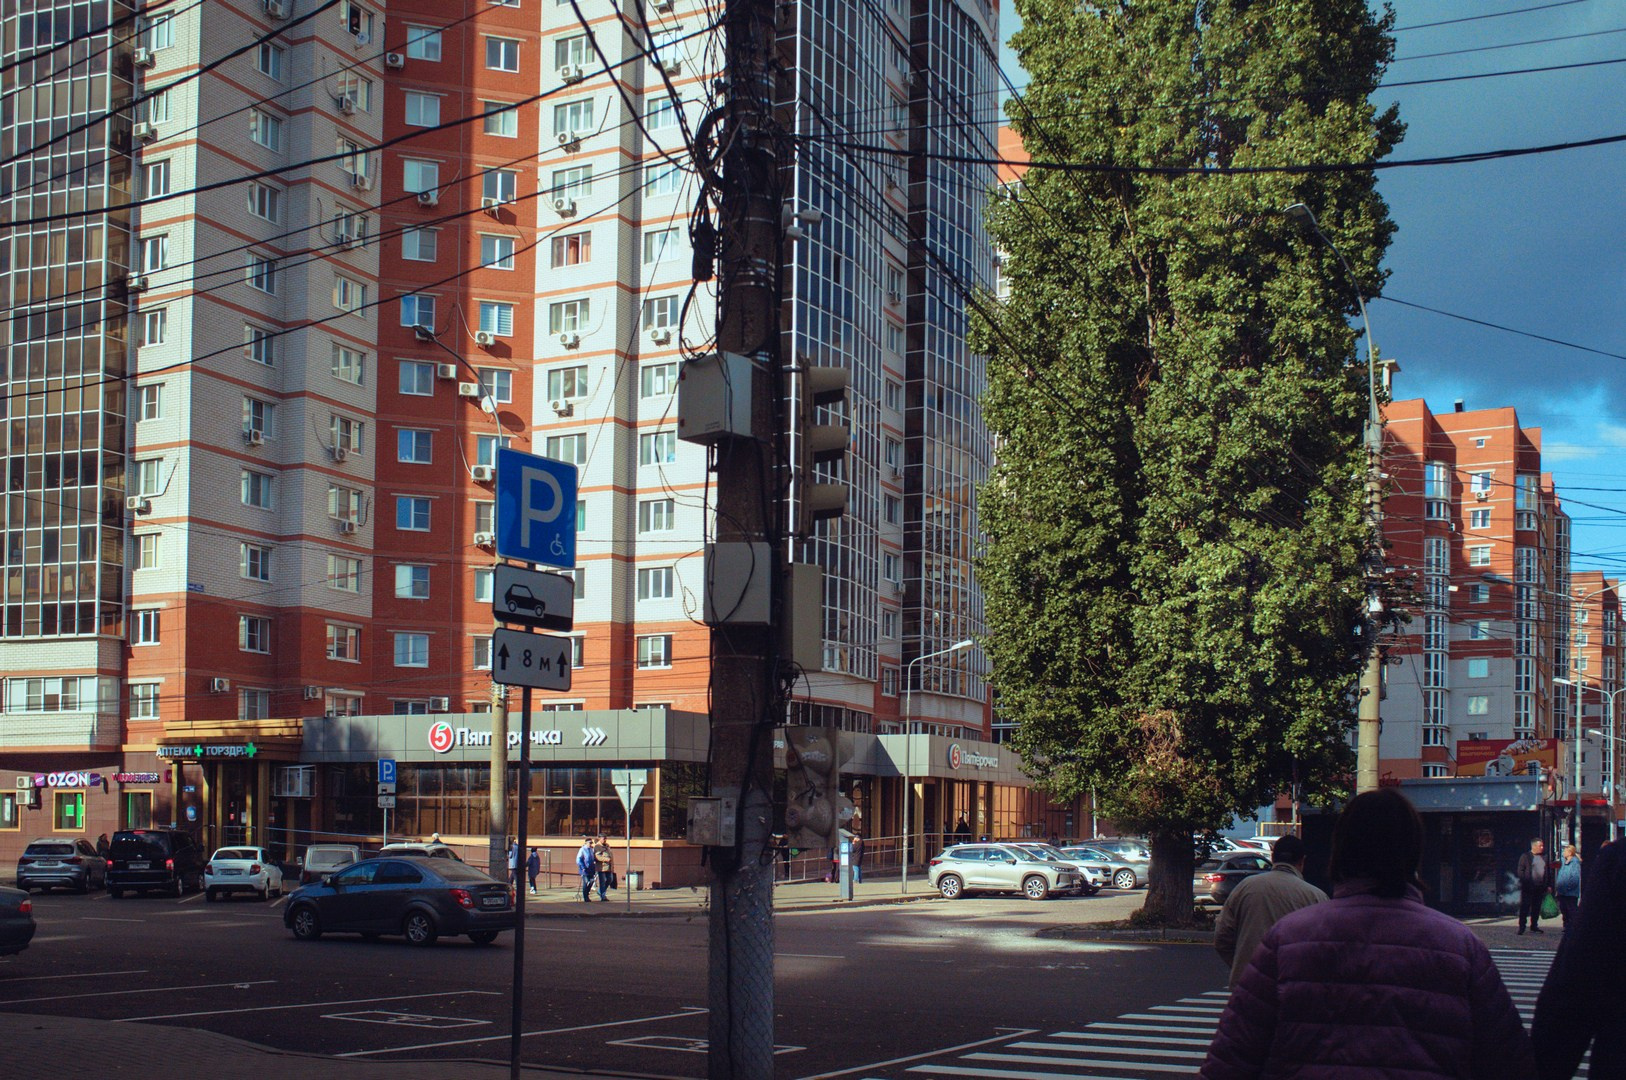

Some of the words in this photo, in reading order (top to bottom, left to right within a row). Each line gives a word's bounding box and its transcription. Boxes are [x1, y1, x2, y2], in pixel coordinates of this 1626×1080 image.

[521, 465, 563, 548] P
[522, 649, 532, 668] 8
[456, 727, 562, 749] Пятрчка
[156, 745, 192, 757] АПТЕКИ
[47, 772, 88, 787] OZON
[383, 761, 393, 781] P
